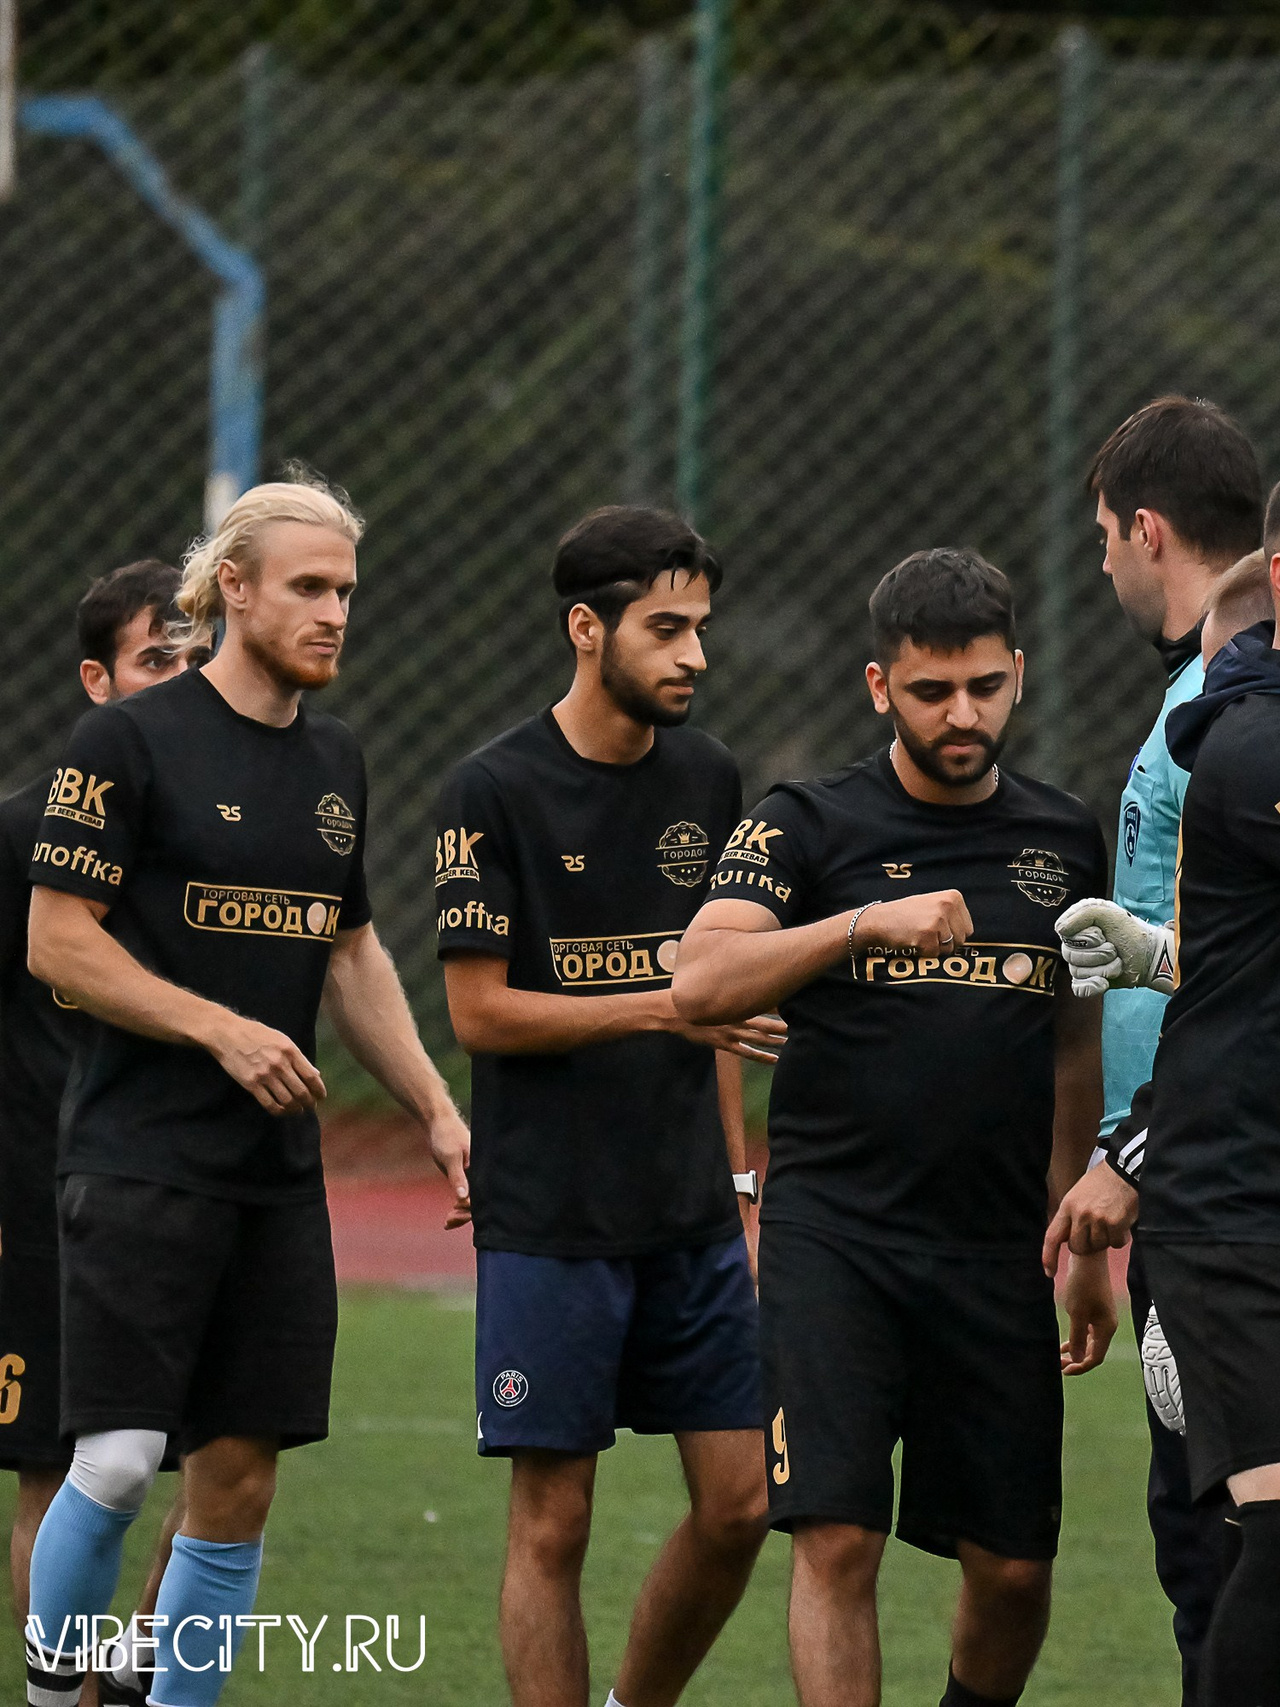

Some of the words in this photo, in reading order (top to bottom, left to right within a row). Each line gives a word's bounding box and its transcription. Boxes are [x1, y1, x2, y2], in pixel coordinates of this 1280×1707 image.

[202, 888, 262, 902] ТОРГОВАЯ
[264, 893, 291, 905] СЕТЬ
[606, 940, 635, 952] СЕТЬ
[500, 1372, 524, 1383] PARIS
[0, 1352, 26, 1425] 6
[771, 1406, 790, 1485] 9
